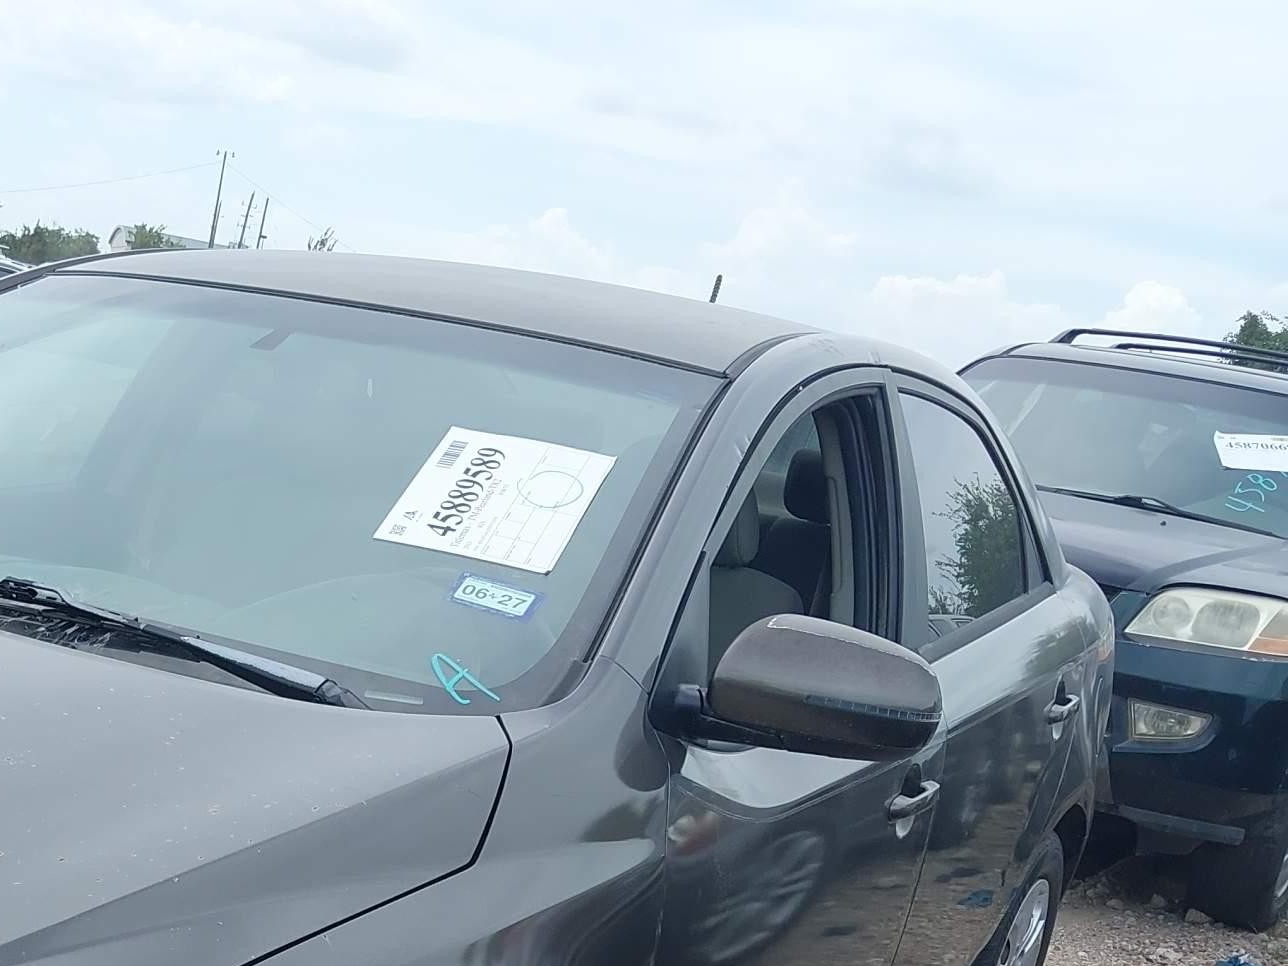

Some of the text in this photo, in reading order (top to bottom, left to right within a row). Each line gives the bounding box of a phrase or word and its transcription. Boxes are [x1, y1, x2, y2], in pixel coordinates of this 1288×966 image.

[427, 447, 506, 537] 45889589
[461, 584, 490, 600] 06
[497, 594, 528, 609] 27
[431, 653, 500, 705] A
